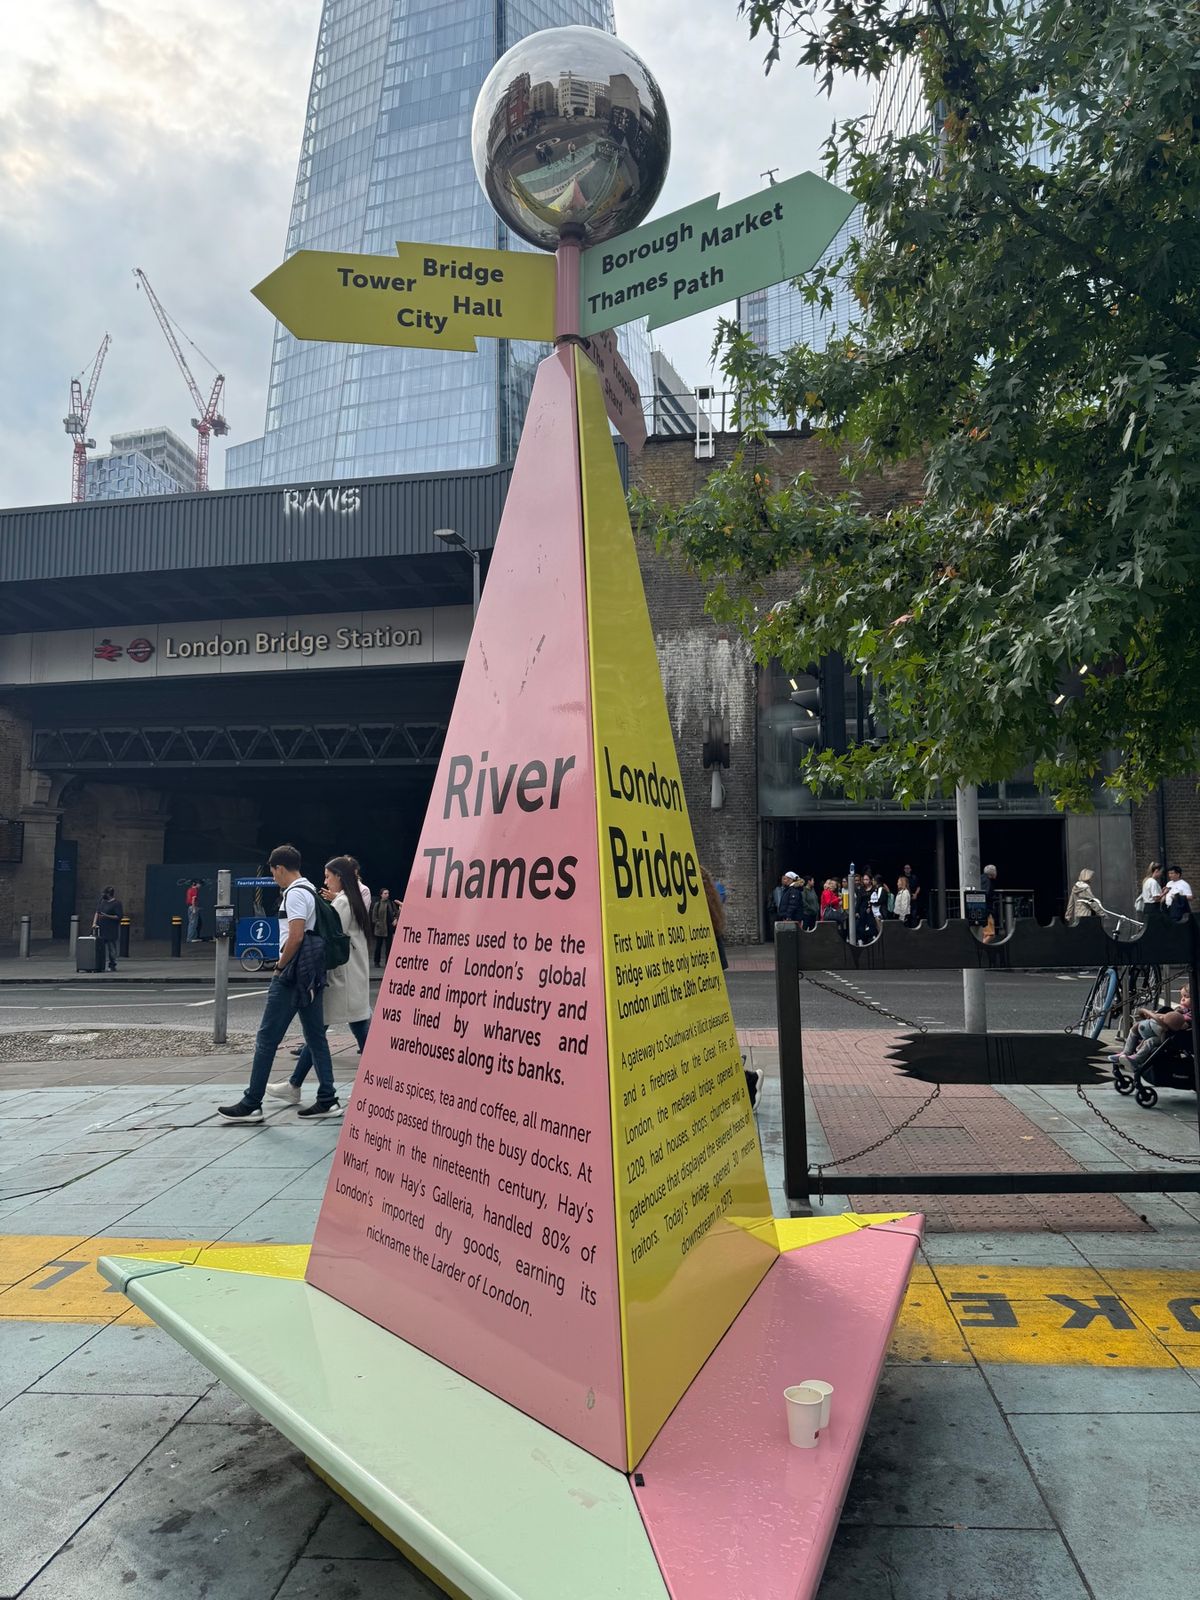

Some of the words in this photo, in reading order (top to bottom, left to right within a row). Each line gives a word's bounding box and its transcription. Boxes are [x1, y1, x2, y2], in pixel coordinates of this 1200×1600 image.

[602, 223, 693, 274] Borough
[701, 202, 784, 252] Market
[337, 268, 417, 292] Tower
[423, 258, 504, 286] Bridge
[588, 271, 668, 314] Thames
[674, 266, 724, 300] Path
[397, 308, 448, 334] City
[453, 296, 503, 317] Hall
[592, 339, 604, 373] The
[605, 378, 622, 416] Shard
[166, 635, 248, 660] London
[256, 630, 329, 657] Bridge
[336, 625, 421, 650] Station
[443, 750, 576, 820] River
[604, 746, 683, 812] London
[423, 847, 578, 900] Thames
[608, 826, 699, 915] Bridge
[403, 926, 422, 944] The
[427, 927, 470, 947] Thames
[476, 930, 507, 949] used
[513, 932, 528, 951] to
[534, 932, 553, 953] be
[560, 933, 586, 955] the
[613, 933, 633, 953] First
[635, 930, 655, 950] built
[657, 929, 666, 946] in
[667, 926, 687, 945] 50AD,
[688, 923, 711, 941] London
[616, 963, 643, 987] Bridge
[645, 961, 660, 979] was
[663, 957, 674, 974] the
[676, 953, 689, 974] only
[690, 949, 709, 969] bridge
[709, 947, 716, 962] in
[389, 979, 416, 997] trade
[419, 983, 442, 1001] and
[445, 984, 488, 1009] import
[493, 989, 552, 1021] industry
[557, 1000, 588, 1021] and
[395, 954, 429, 972] centre
[439, 956, 454, 974] of
[464, 957, 524, 981] London's
[538, 964, 587, 989] global
[617, 994, 650, 1020] London
[651, 986, 670, 1008] until
[670, 984, 683, 1002] the
[683, 978, 697, 998] 18th
[697, 975, 722, 993] Century.
[382, 1007, 402, 1023] was
[413, 1007, 441, 1030] lined
[453, 1014, 469, 1039] by
[483, 1020, 541, 1047] wharves
[558, 1034, 589, 1055] and
[390, 1036, 455, 1062] warehouses
[457, 1046, 495, 1075] along
[497, 1052, 514, 1075] its
[517, 1056, 564, 1086] banks.
[622, 1052, 627, 1070] A
[627, 1043, 655, 1071] gateway
[656, 1039, 664, 1053] to
[622, 1083, 637, 1107] and
[641, 1084, 646, 1096] a
[650, 1064, 678, 1091] firebreak
[681, 1060, 689, 1075] for
[692, 1054, 701, 1068] the
[703, 1044, 717, 1062] Great
[718, 1040, 727, 1054] Fire
[729, 1033, 734, 1048] of
[625, 1117, 654, 1145] London,
[657, 1106, 669, 1124] the
[671, 1086, 697, 1115] medieval
[717, 1063, 734, 1086] opened
[734, 1061, 739, 1073] in
[363, 1070, 375, 1086] As
[376, 1075, 394, 1091] well
[394, 1080, 405, 1094] as
[405, 1082, 436, 1104] spices,
[439, 1089, 455, 1107] tea
[456, 1097, 478, 1113] and
[479, 1102, 519, 1127] coffee,
[522, 1111, 537, 1130] all
[540, 1118, 591, 1144] manner
[627, 1155, 647, 1184] 1209,
[649, 1142, 664, 1167] had
[710, 1098, 730, 1122] churches
[732, 1088, 740, 1105] and
[741, 1088, 745, 1098] a
[349, 1123, 360, 1140] its
[364, 1128, 392, 1152] height
[396, 1139, 406, 1157] in
[411, 1145, 427, 1164] the
[432, 1155, 490, 1187] nineteenth
[498, 1178, 547, 1210] century,
[557, 1193, 594, 1224] Hay's
[356, 1098, 367, 1112] of
[367, 1103, 395, 1121] goods
[396, 1112, 429, 1132] passed
[431, 1119, 473, 1148] through
[476, 1132, 495, 1153] the
[498, 1137, 528, 1167] busy
[530, 1148, 572, 1177] docks.
[576, 1162, 592, 1184] At
[630, 1183, 666, 1229] gatehouse
[667, 1169, 680, 1192] that
[681, 1146, 707, 1180] displayed
[706, 1142, 716, 1158] the
[715, 1124, 733, 1151] severed
[732, 1117, 745, 1135] heads
[745, 1109, 749, 1124] of
[343, 1150, 369, 1176] Wharf,
[374, 1167, 395, 1184] now
[400, 1172, 426, 1198] Hay's
[432, 1185, 474, 1219] Galleria,
[483, 1204, 533, 1240] handled
[541, 1226, 571, 1254] 80%
[580, 1245, 597, 1264] of
[664, 1200, 688, 1232] Today's
[691, 1182, 710, 1207] bridge
[713, 1159, 730, 1189] opened
[732, 1150, 739, 1167] 30
[336, 1178, 374, 1207] London's
[381, 1198, 425, 1230] imported
[435, 1221, 453, 1246] dry
[463, 1236, 502, 1267] goods,
[515, 1259, 565, 1296] earning
[580, 1281, 597, 1306] its
[682, 1211, 716, 1255] downstream
[716, 1205, 721, 1219] in
[366, 1226, 411, 1257] nickname
[412, 1245, 429, 1266] the
[431, 1253, 466, 1283] Larder
[467, 1274, 482, 1290] of
[482, 1277, 532, 1317] London.
